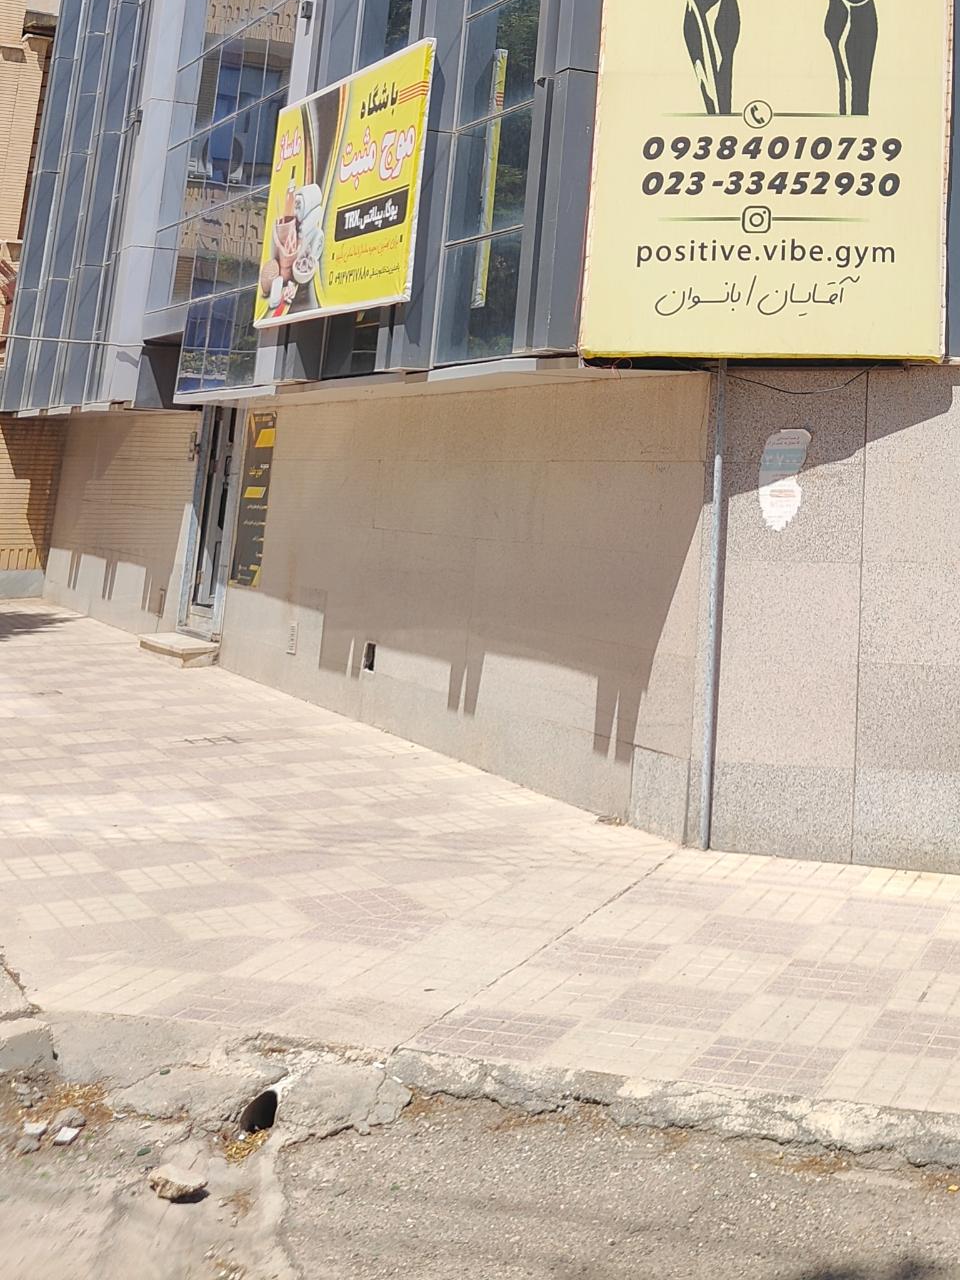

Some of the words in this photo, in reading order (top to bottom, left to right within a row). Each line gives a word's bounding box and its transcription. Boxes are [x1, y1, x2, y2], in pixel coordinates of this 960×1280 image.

[339, 125, 378, 191] مثبت
[379, 124, 416, 181] موج
[641, 135, 903, 162] 09384010739
[641, 170, 901, 197] 023-33452930
[635, 238, 897, 269] positive.vibe.gym
